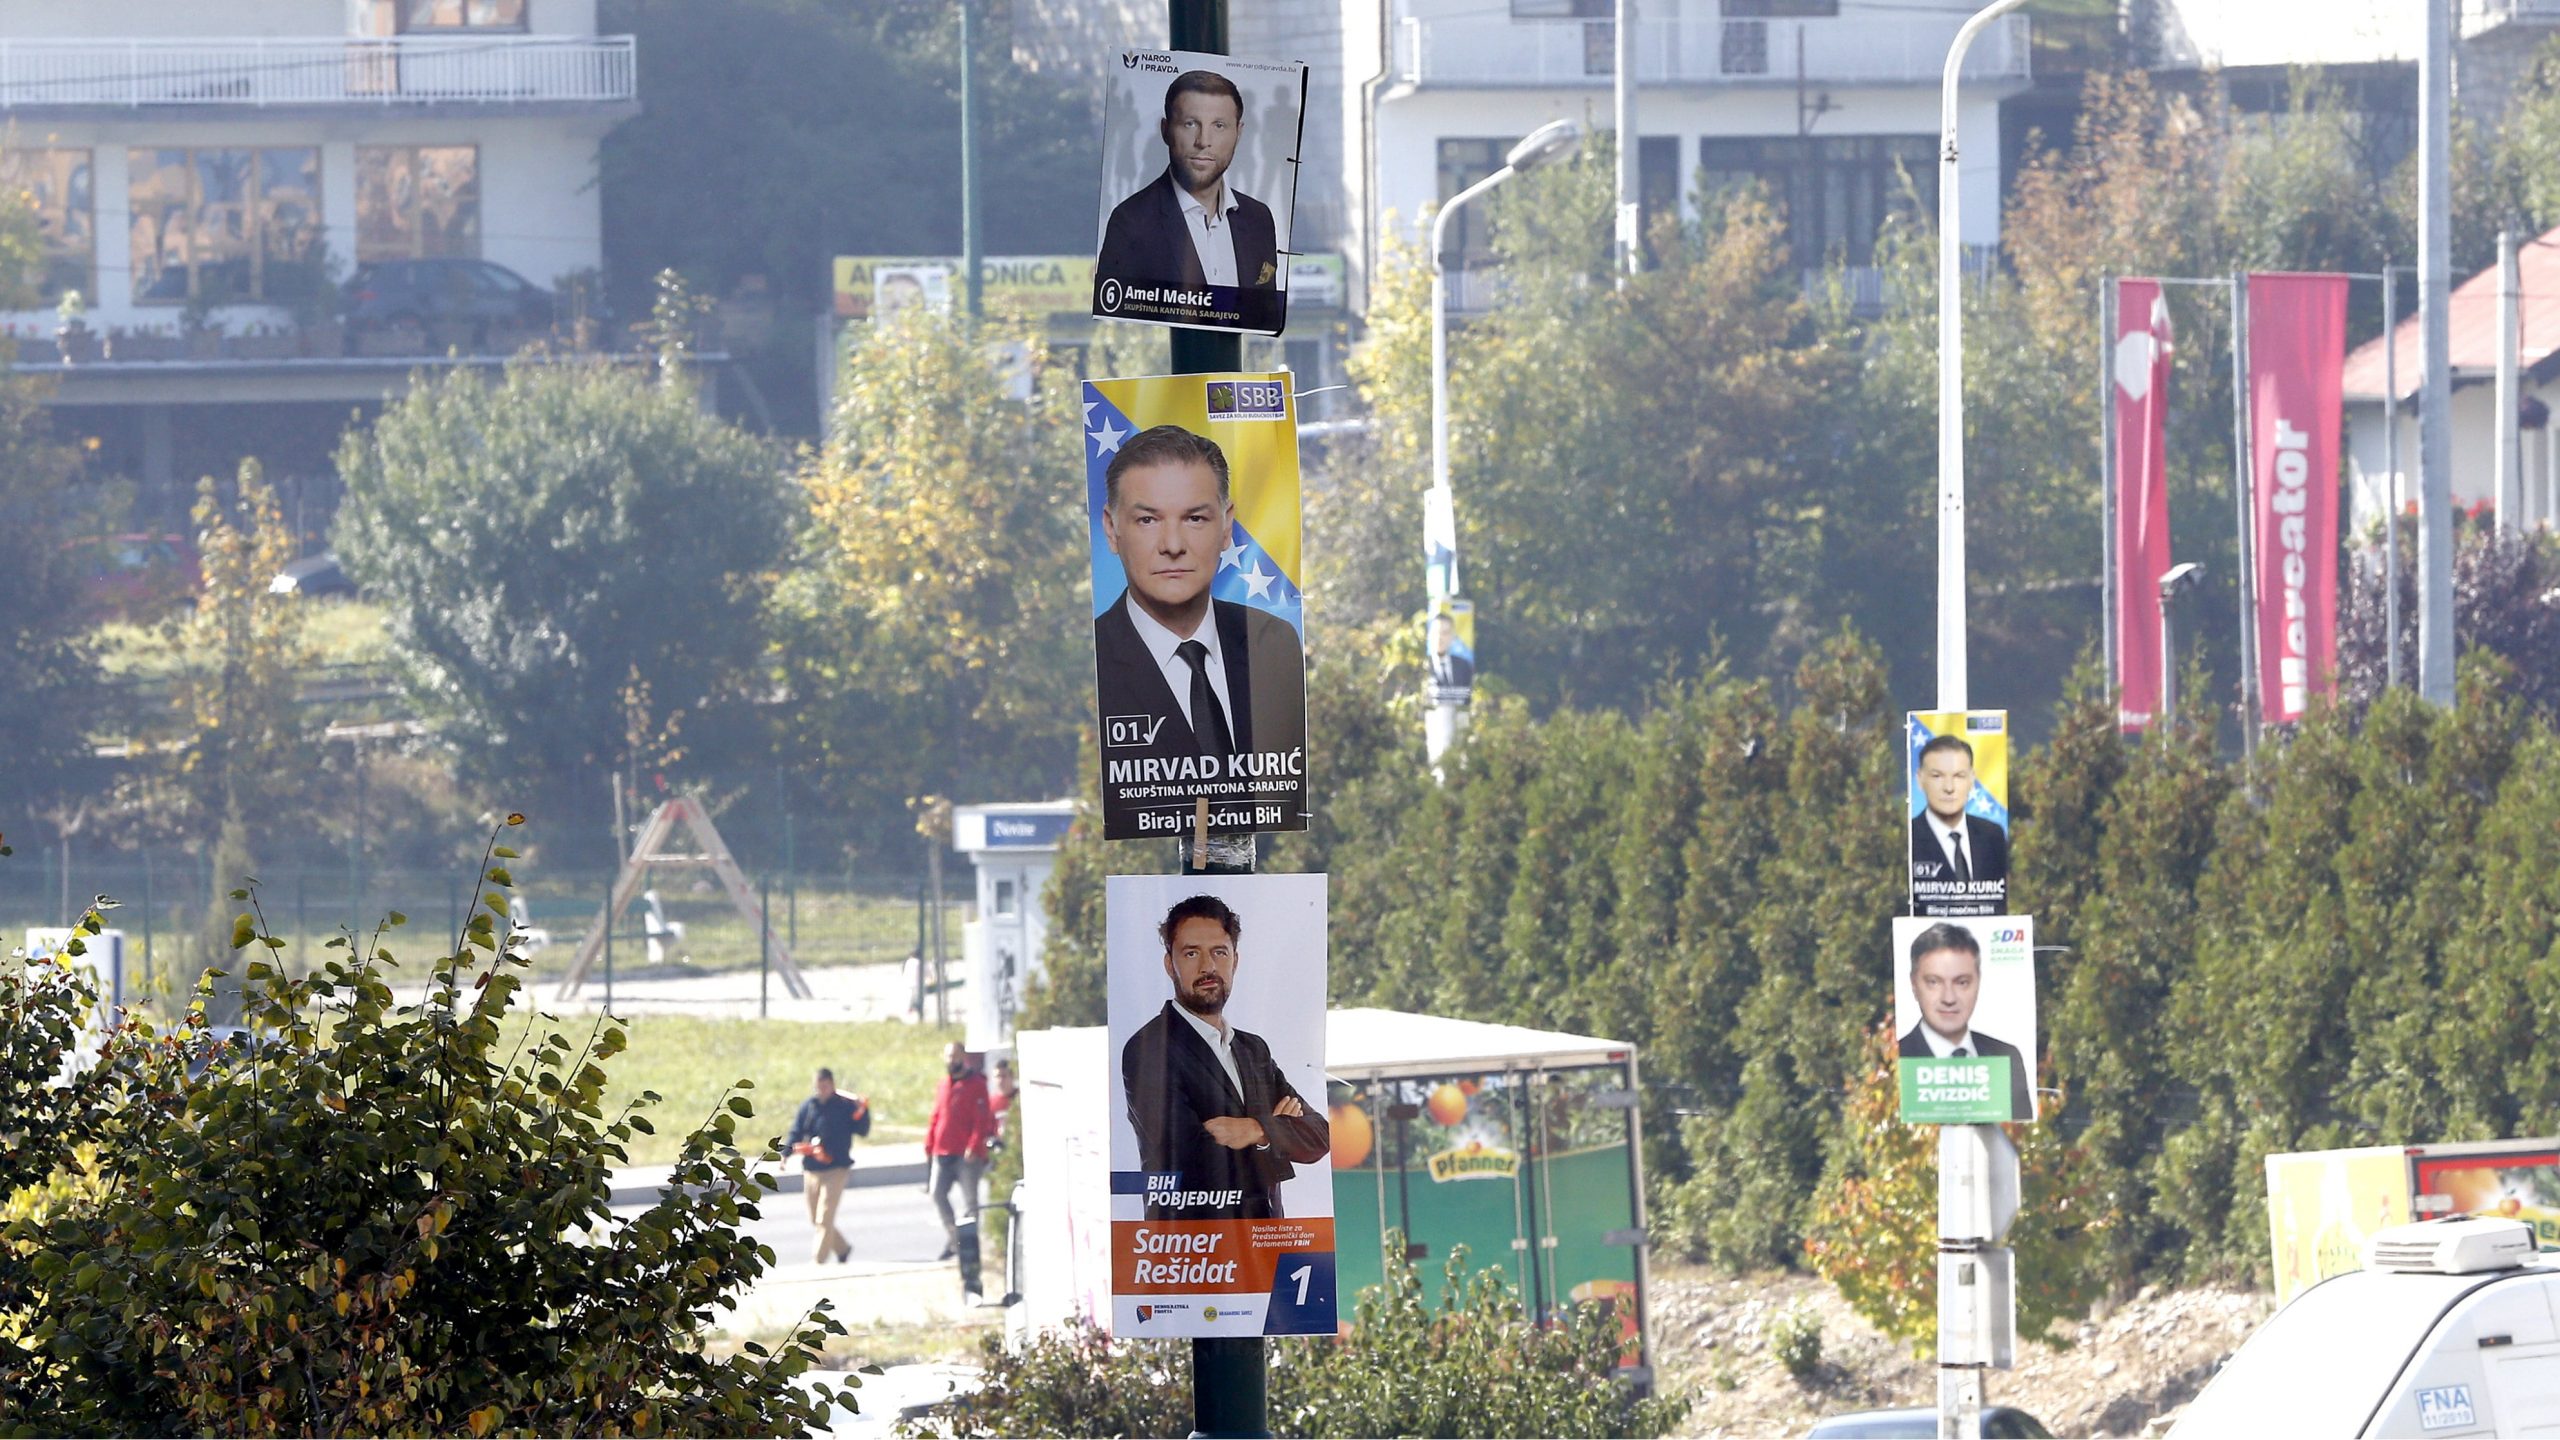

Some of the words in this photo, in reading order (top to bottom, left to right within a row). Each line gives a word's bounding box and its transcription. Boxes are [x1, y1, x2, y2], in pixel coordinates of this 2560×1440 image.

[1141, 54, 1171, 63] NAROD
[1225, 62, 1297, 73] www.narodipravda.ba
[1145, 64, 1179, 74] PRAVDA
[1106, 286, 1115, 304] 6
[1125, 285, 1160, 302] Amel
[1163, 289, 1214, 307] Mekić
[1124, 302, 1159, 313] SKUPŠTINA
[1160, 307, 1198, 317] KANTONA
[1199, 310, 1240, 320] SARAJEVO
[1240, 387, 1280, 407] SBB
[1111, 721, 1138, 742] 01
[1108, 755, 1220, 784] MIRVAD
[1228, 747, 1302, 778] KURIĆ
[1119, 785, 1185, 799] SKUPŠTINA
[1187, 782, 1246, 795] KANTONA
[1248, 780, 1299, 793] SARAJEVO
[1138, 810, 1181, 833] Biraj
[1255, 806, 1282, 825] BiH
[1916, 864, 1930, 876] 01
[1914, 881, 1967, 894] MIRVAD
[1968, 877, 2005, 893] KURIĆ
[1990, 929, 2024, 943] SDA
[1916, 1065, 1990, 1085] DENIS
[1917, 1084, 1990, 1102] ZVIZDIĆ
[1147, 1175, 1176, 1190] BIH
[1147, 1190, 1243, 1210] POBJEĐUJE!
[1252, 1225, 1278, 1233] Nosilac
[1278, 1224, 1293, 1232] liste
[1252, 1232, 1298, 1240] Predstavnički
[1133, 1228, 1223, 1254] Samer
[1252, 1240, 1293, 1248] Parlamenta
[1134, 1257, 1238, 1284] Rešidat
[1290, 1265, 1312, 1306] 1
[2420, 1389, 2469, 1412] FNA
